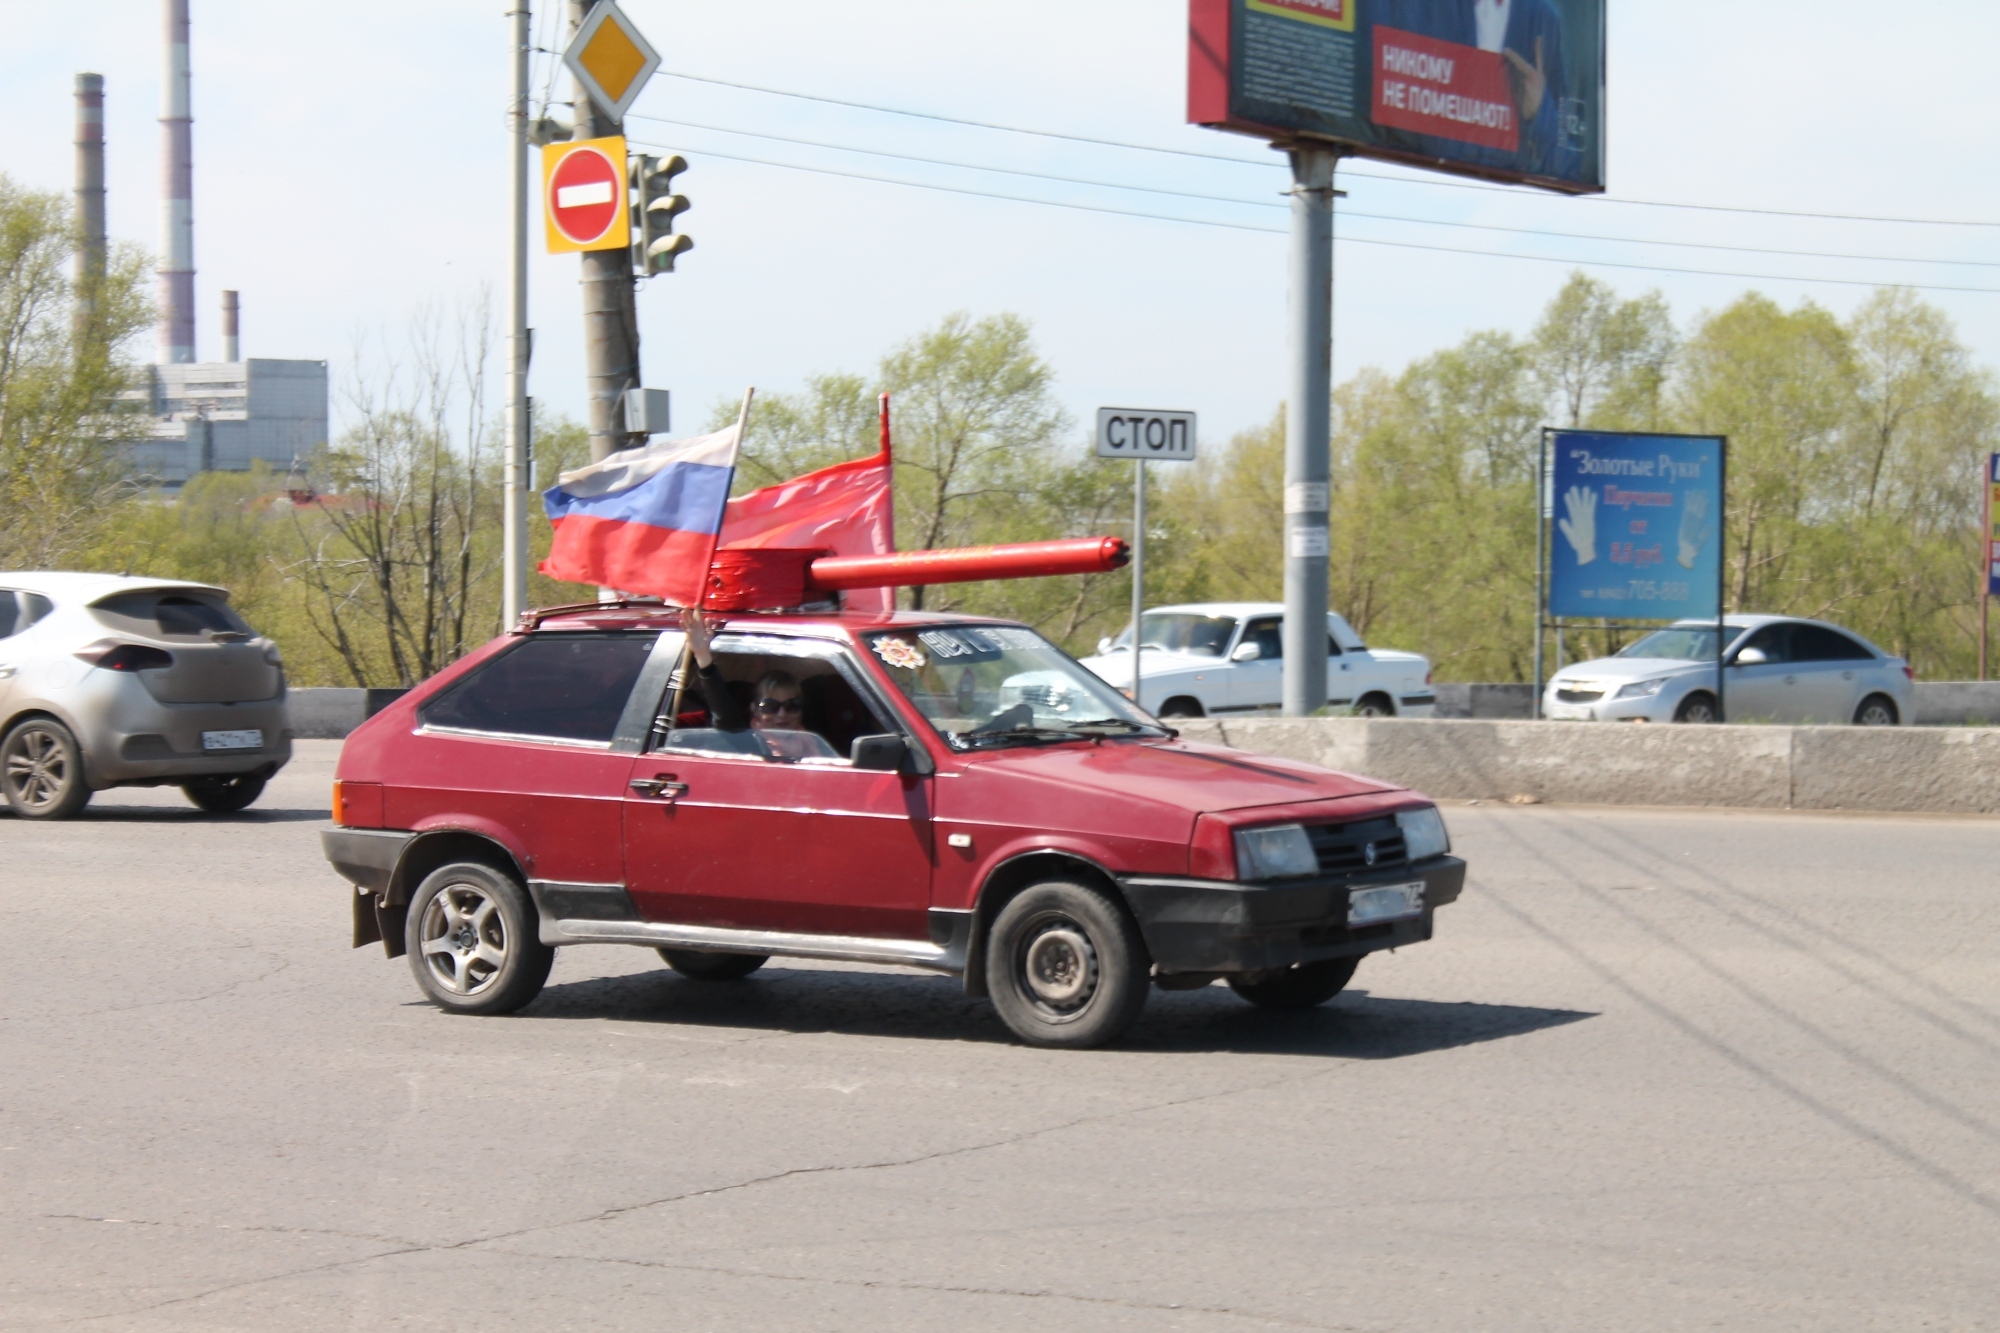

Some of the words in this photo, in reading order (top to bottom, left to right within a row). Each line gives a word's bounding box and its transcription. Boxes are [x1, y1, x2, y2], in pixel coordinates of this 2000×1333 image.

[1382, 44, 1455, 85] НИКОМУ
[1382, 79, 1406, 109] НЕ
[1408, 85, 1511, 131] ПОМЕШАЮТ!
[1106, 415, 1188, 451] СТОП
